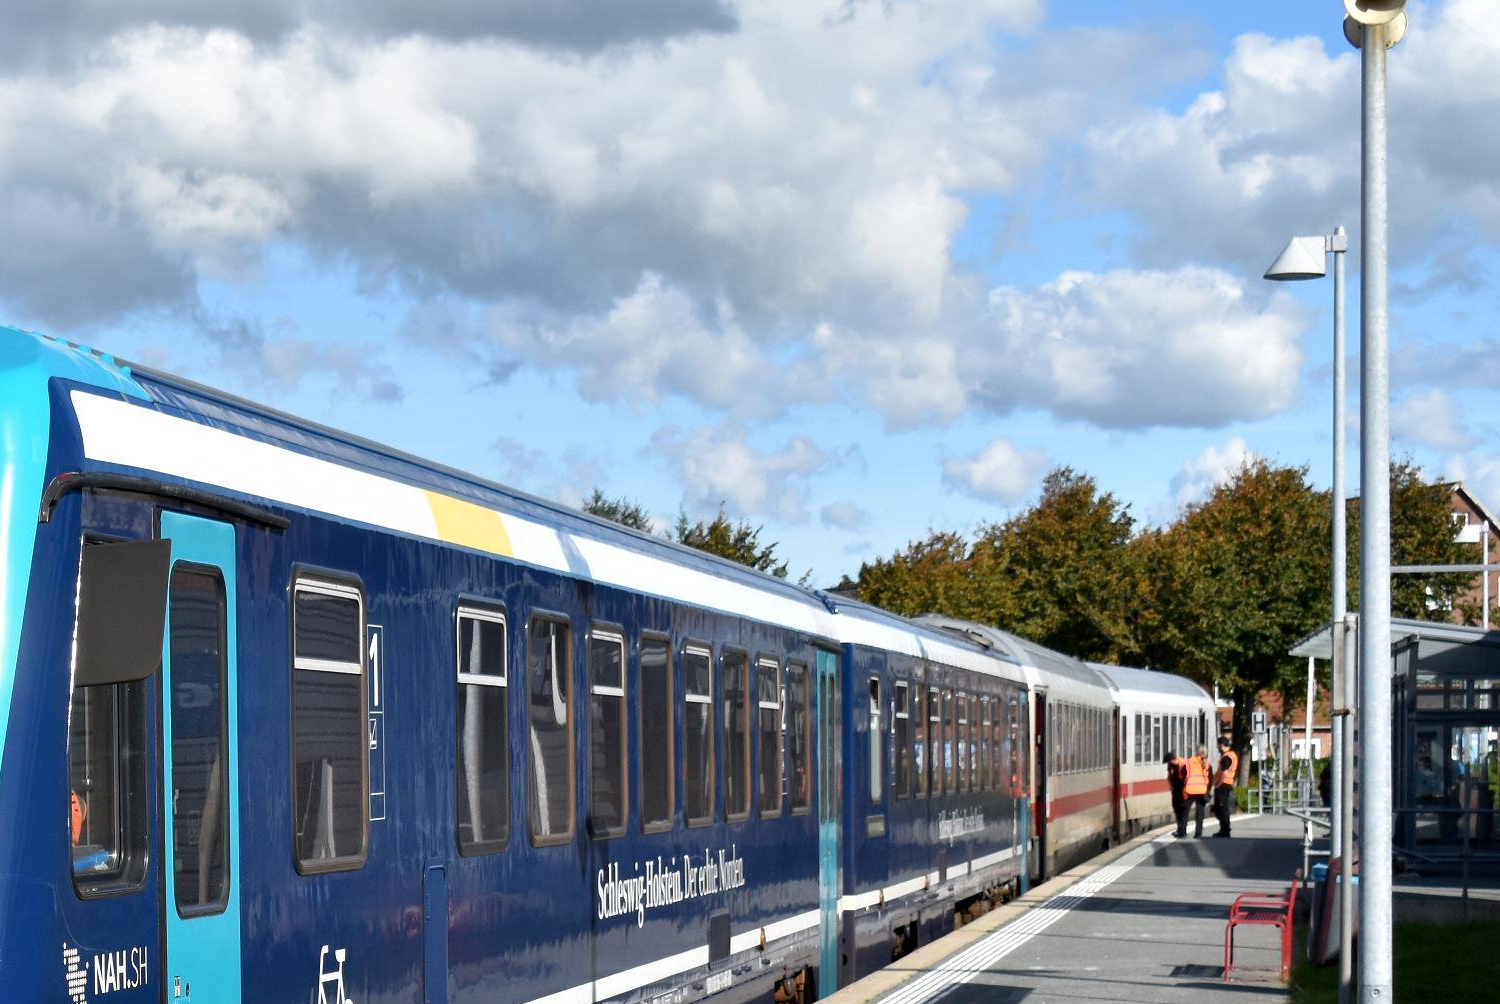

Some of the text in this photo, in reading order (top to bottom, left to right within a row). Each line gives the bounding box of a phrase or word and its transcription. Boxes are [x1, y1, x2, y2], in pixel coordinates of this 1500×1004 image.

[1253, 713, 1265, 731] H
[598, 855, 683, 929] Schleswig-Holstein.
[684, 855, 698, 899] Der
[699, 848, 718, 896] echte
[94, 946, 148, 995] NAH.SH
